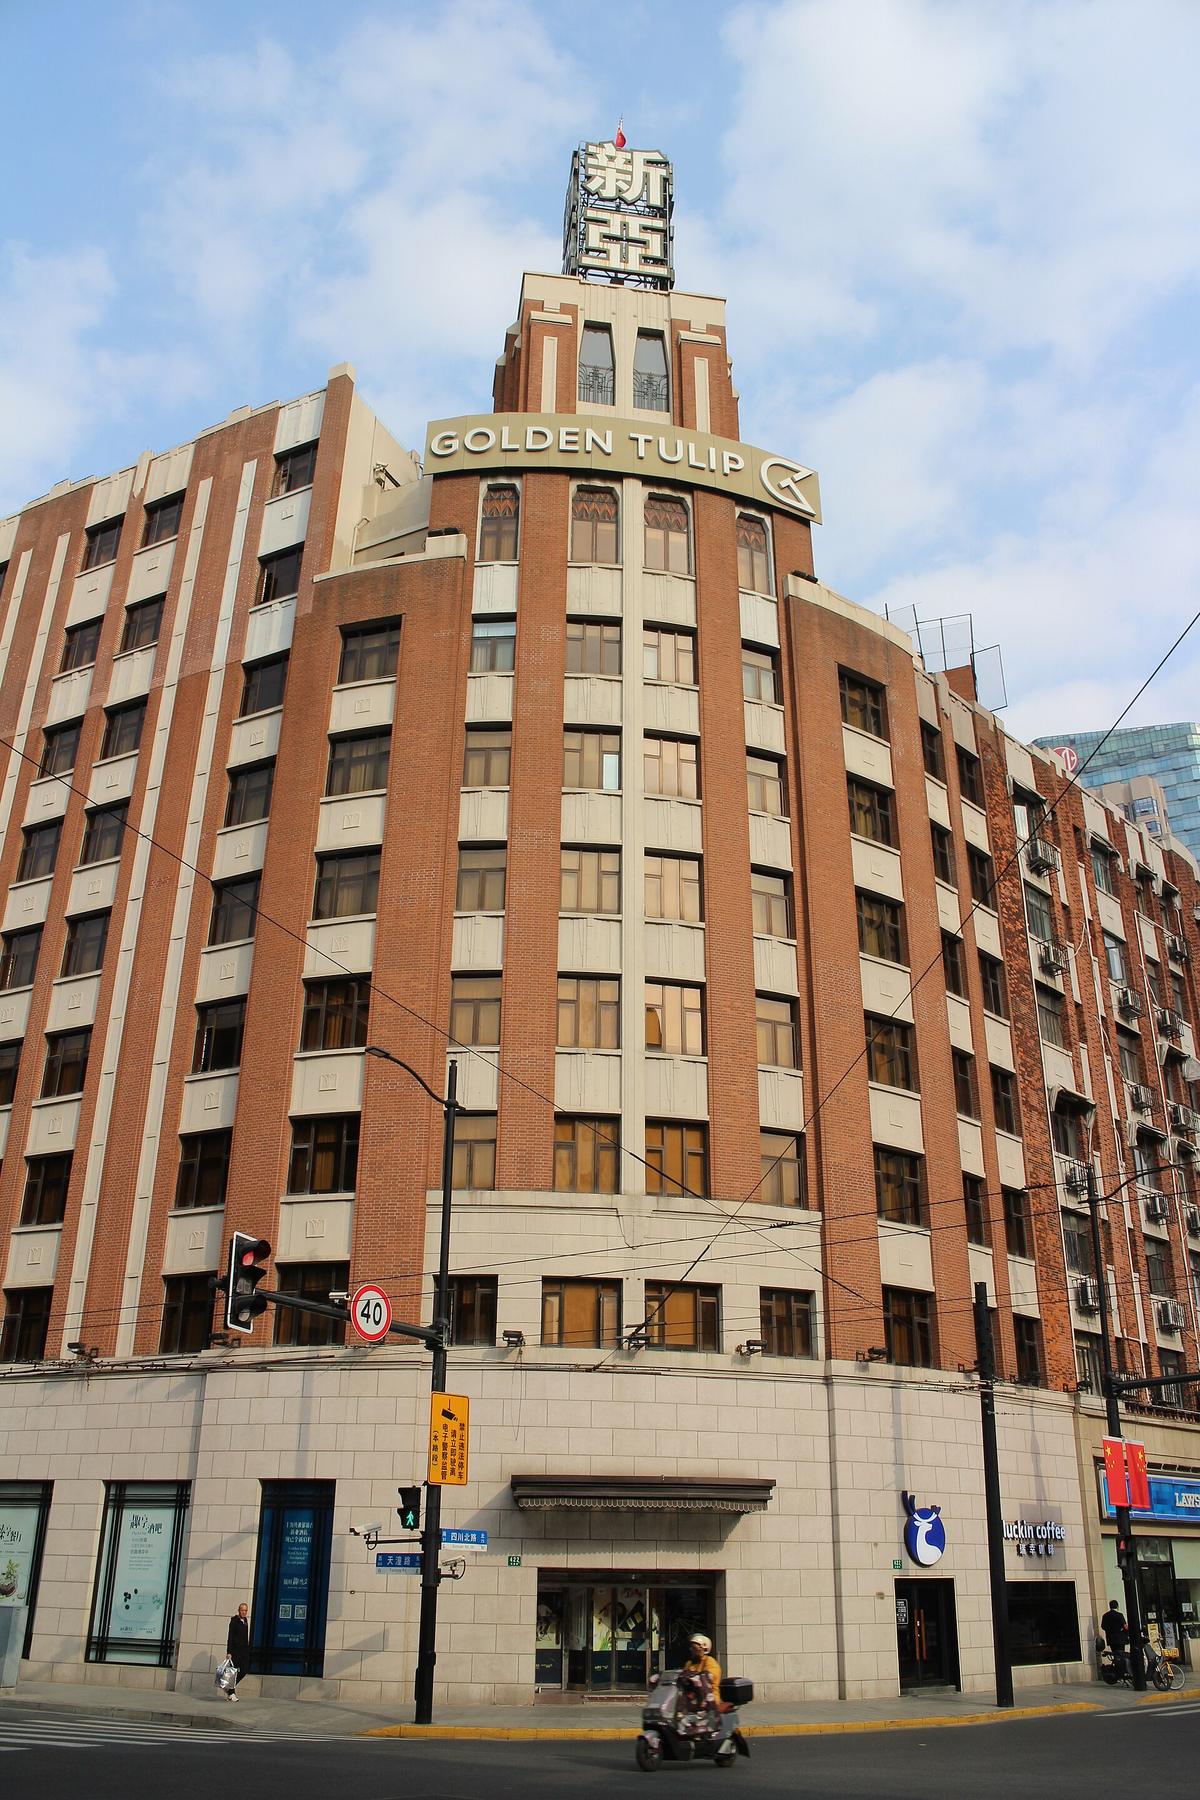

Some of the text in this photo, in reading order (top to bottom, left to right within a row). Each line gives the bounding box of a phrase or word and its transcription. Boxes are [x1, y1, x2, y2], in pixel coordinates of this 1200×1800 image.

[430, 425, 745, 477] GOLDEN TULIP
[361, 1300, 382, 1325] 40
[450, 1532, 477, 1542] 四川北路
[1003, 1520, 1066, 1539] luckin coffee
[1019, 1543, 1055, 1555] 瑞幸咖啡
[386, 1555, 411, 1566] 天潼路
